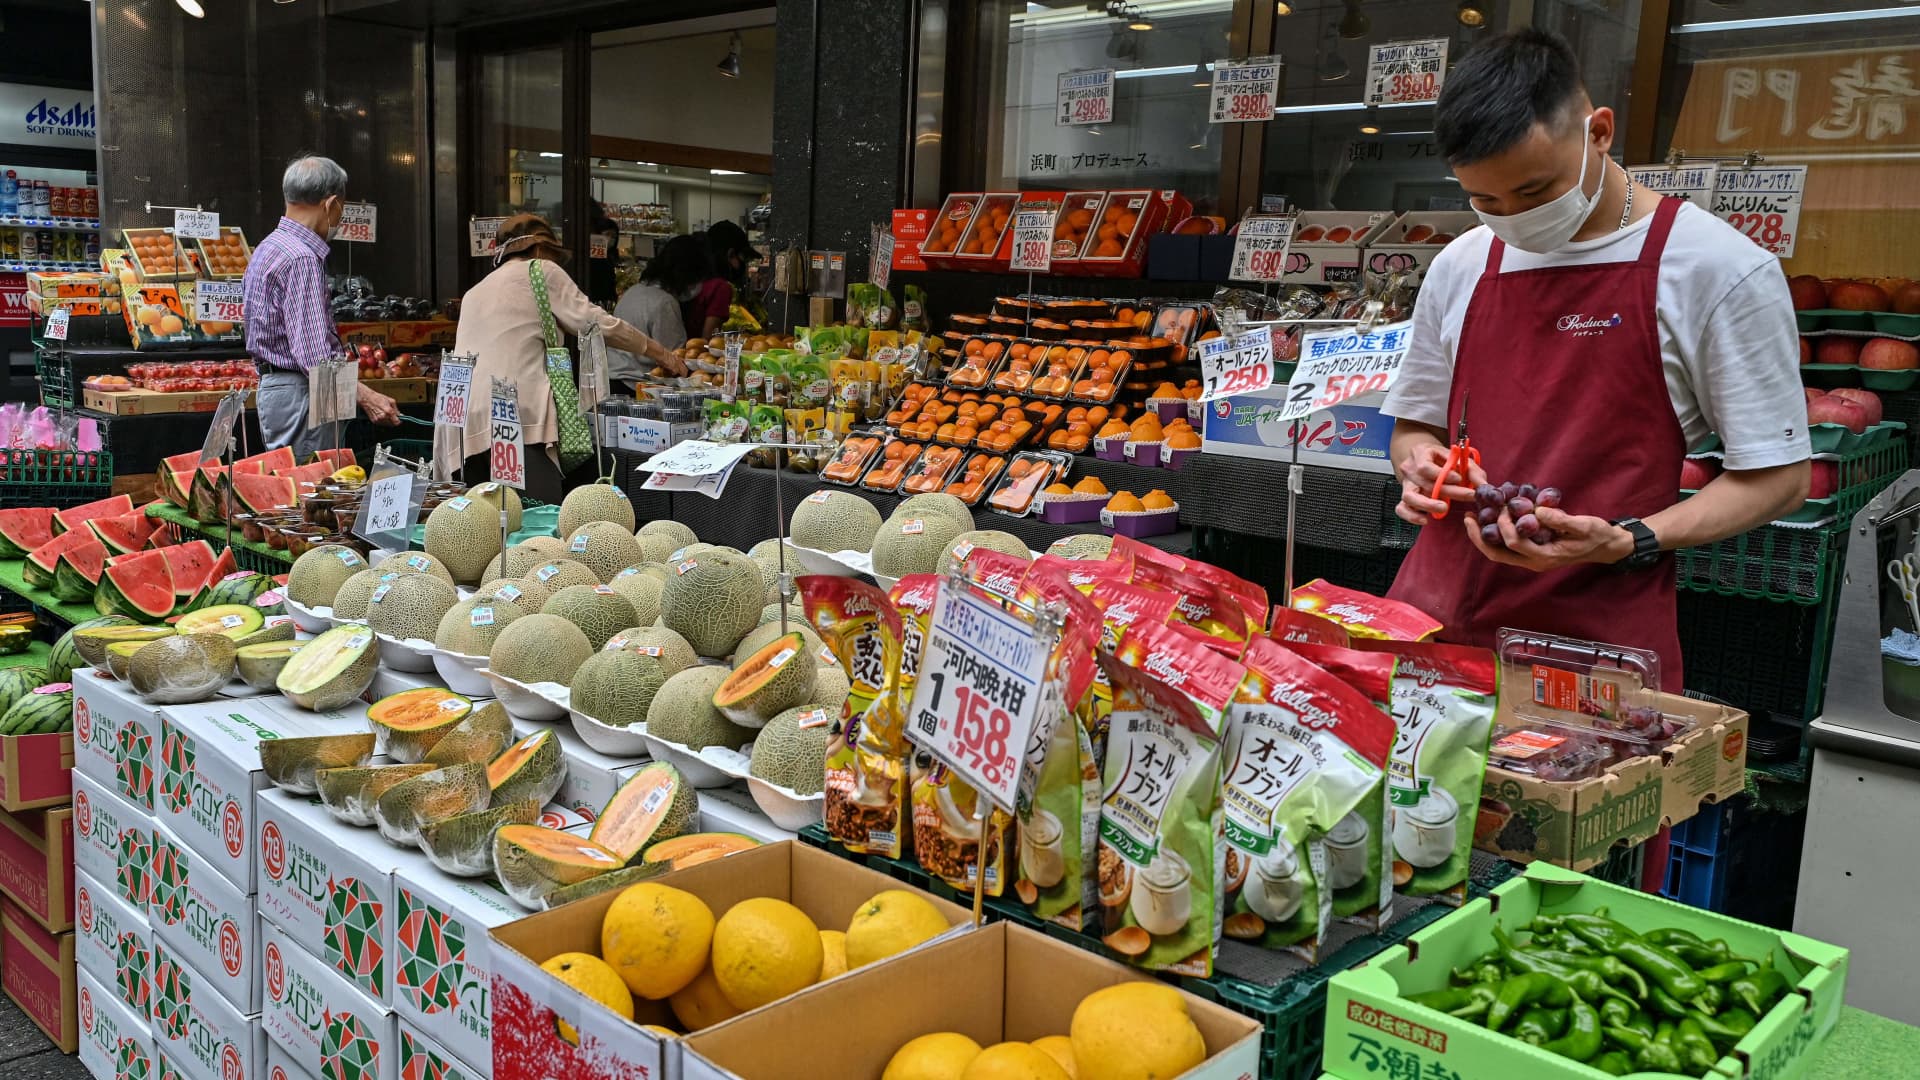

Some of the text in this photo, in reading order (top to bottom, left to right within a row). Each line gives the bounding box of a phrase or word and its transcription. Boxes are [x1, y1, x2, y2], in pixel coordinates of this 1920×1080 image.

[25, 98, 96, 129] Asahi
[1062, 102, 1070, 115] 1
[26, 124, 96, 139] SOFT DRINKS
[1031, 152, 1149, 171] 浜町 プロデュース
[1714, 195, 1792, 214] ふじりんご
[201, 302, 210, 313] 1
[1557, 313, 1612, 331] Produce
[1311, 331, 1406, 358] 毎朝の定番!
[445, 383, 466, 396] ライチ
[1223, 362, 1268, 392] 250
[1291, 382, 1316, 402] 2
[1283, 401, 1311, 418] パック
[628, 425, 660, 438] ブルーベリー
[1287, 419, 1367, 449] りんご
[1324, 603, 1377, 624] Kellogg's
[943, 641, 1027, 718] 河内晩柑
[1143, 651, 1190, 688] Kellogg's
[930, 672, 946, 712] 1
[1270, 682, 1342, 731] Kellogg's
[917, 685, 1017, 779] 個 158円
[1391, 705, 1423, 730] ール
[91, 722, 118, 754] メロン
[1138, 742, 1176, 781] オール
[1249, 737, 1304, 778] オール
[1126, 769, 1167, 808] ブラン
[1237, 762, 1285, 800] ブラン
[91, 816, 118, 850] メロン
[1579, 784, 1659, 852] TABLE GRAPES
[287, 838, 328, 877] JA茨城旭村
[1103, 823, 1145, 861] ブランフレーク
[285, 856, 328, 902] メロン
[264, 890, 301, 923] クインシー
[92, 914, 118, 950] メロン
[284, 981, 322, 1032] メロン
[93, 1016, 118, 1054] メロン
[1349, 1003, 1445, 1051] 京の伝統野菜
